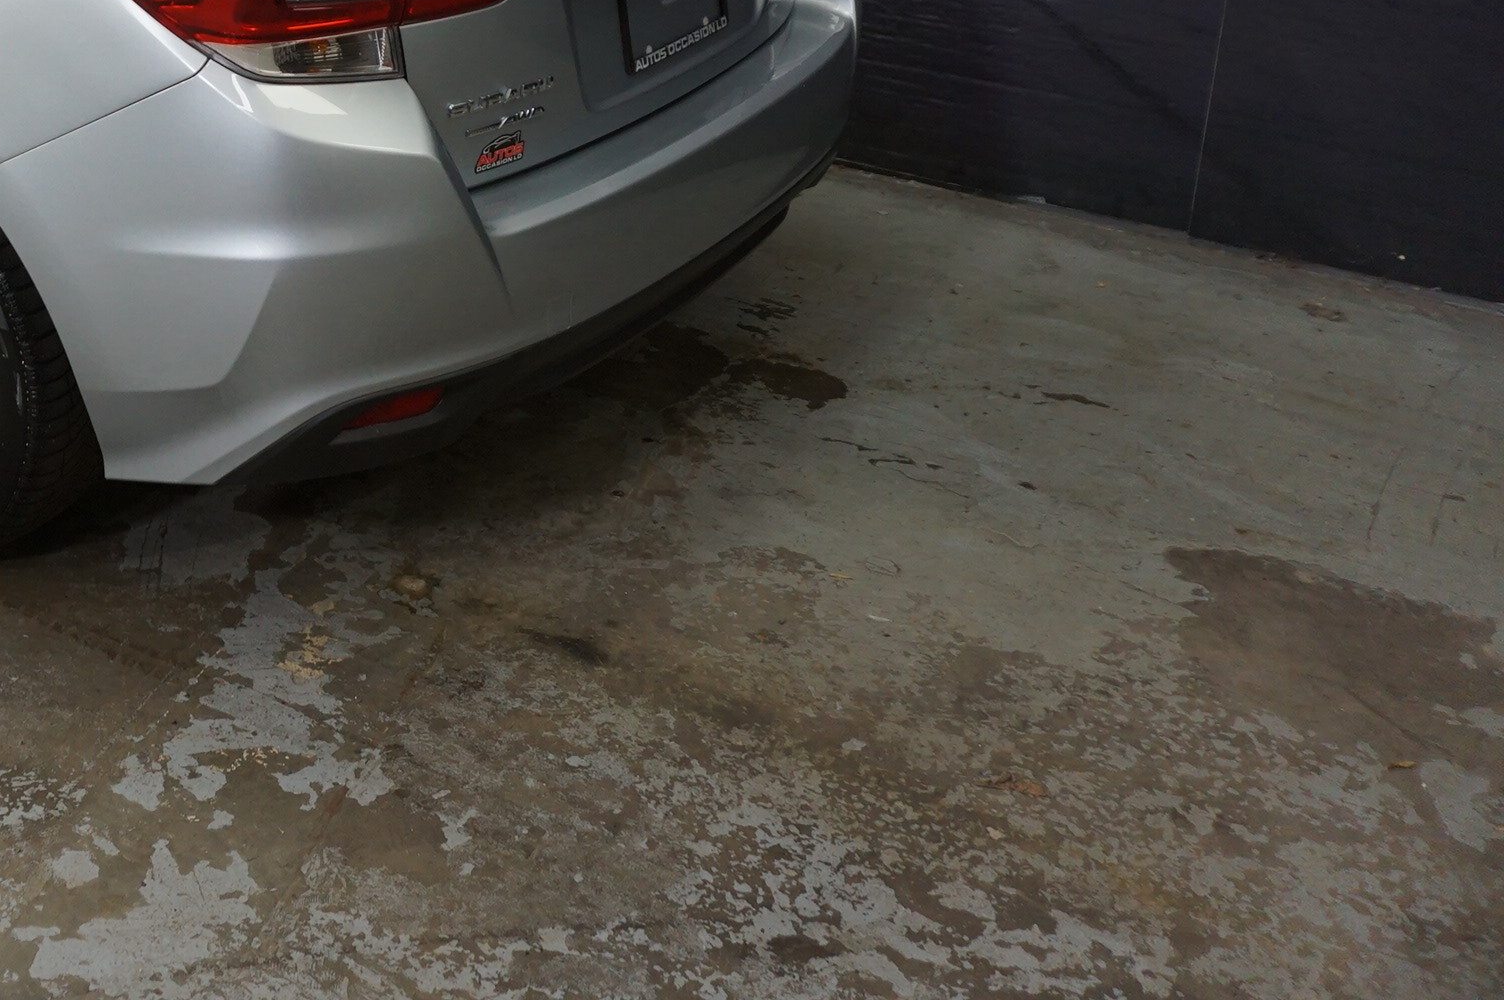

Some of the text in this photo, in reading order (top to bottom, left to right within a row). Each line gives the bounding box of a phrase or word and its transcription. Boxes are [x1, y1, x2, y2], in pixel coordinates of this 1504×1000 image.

[635, 47, 667, 72] AUTOS
[667, 22, 716, 56] OCCASION
[476, 141, 525, 167] AUTOS
[476, 156, 513, 172] OCCASION
